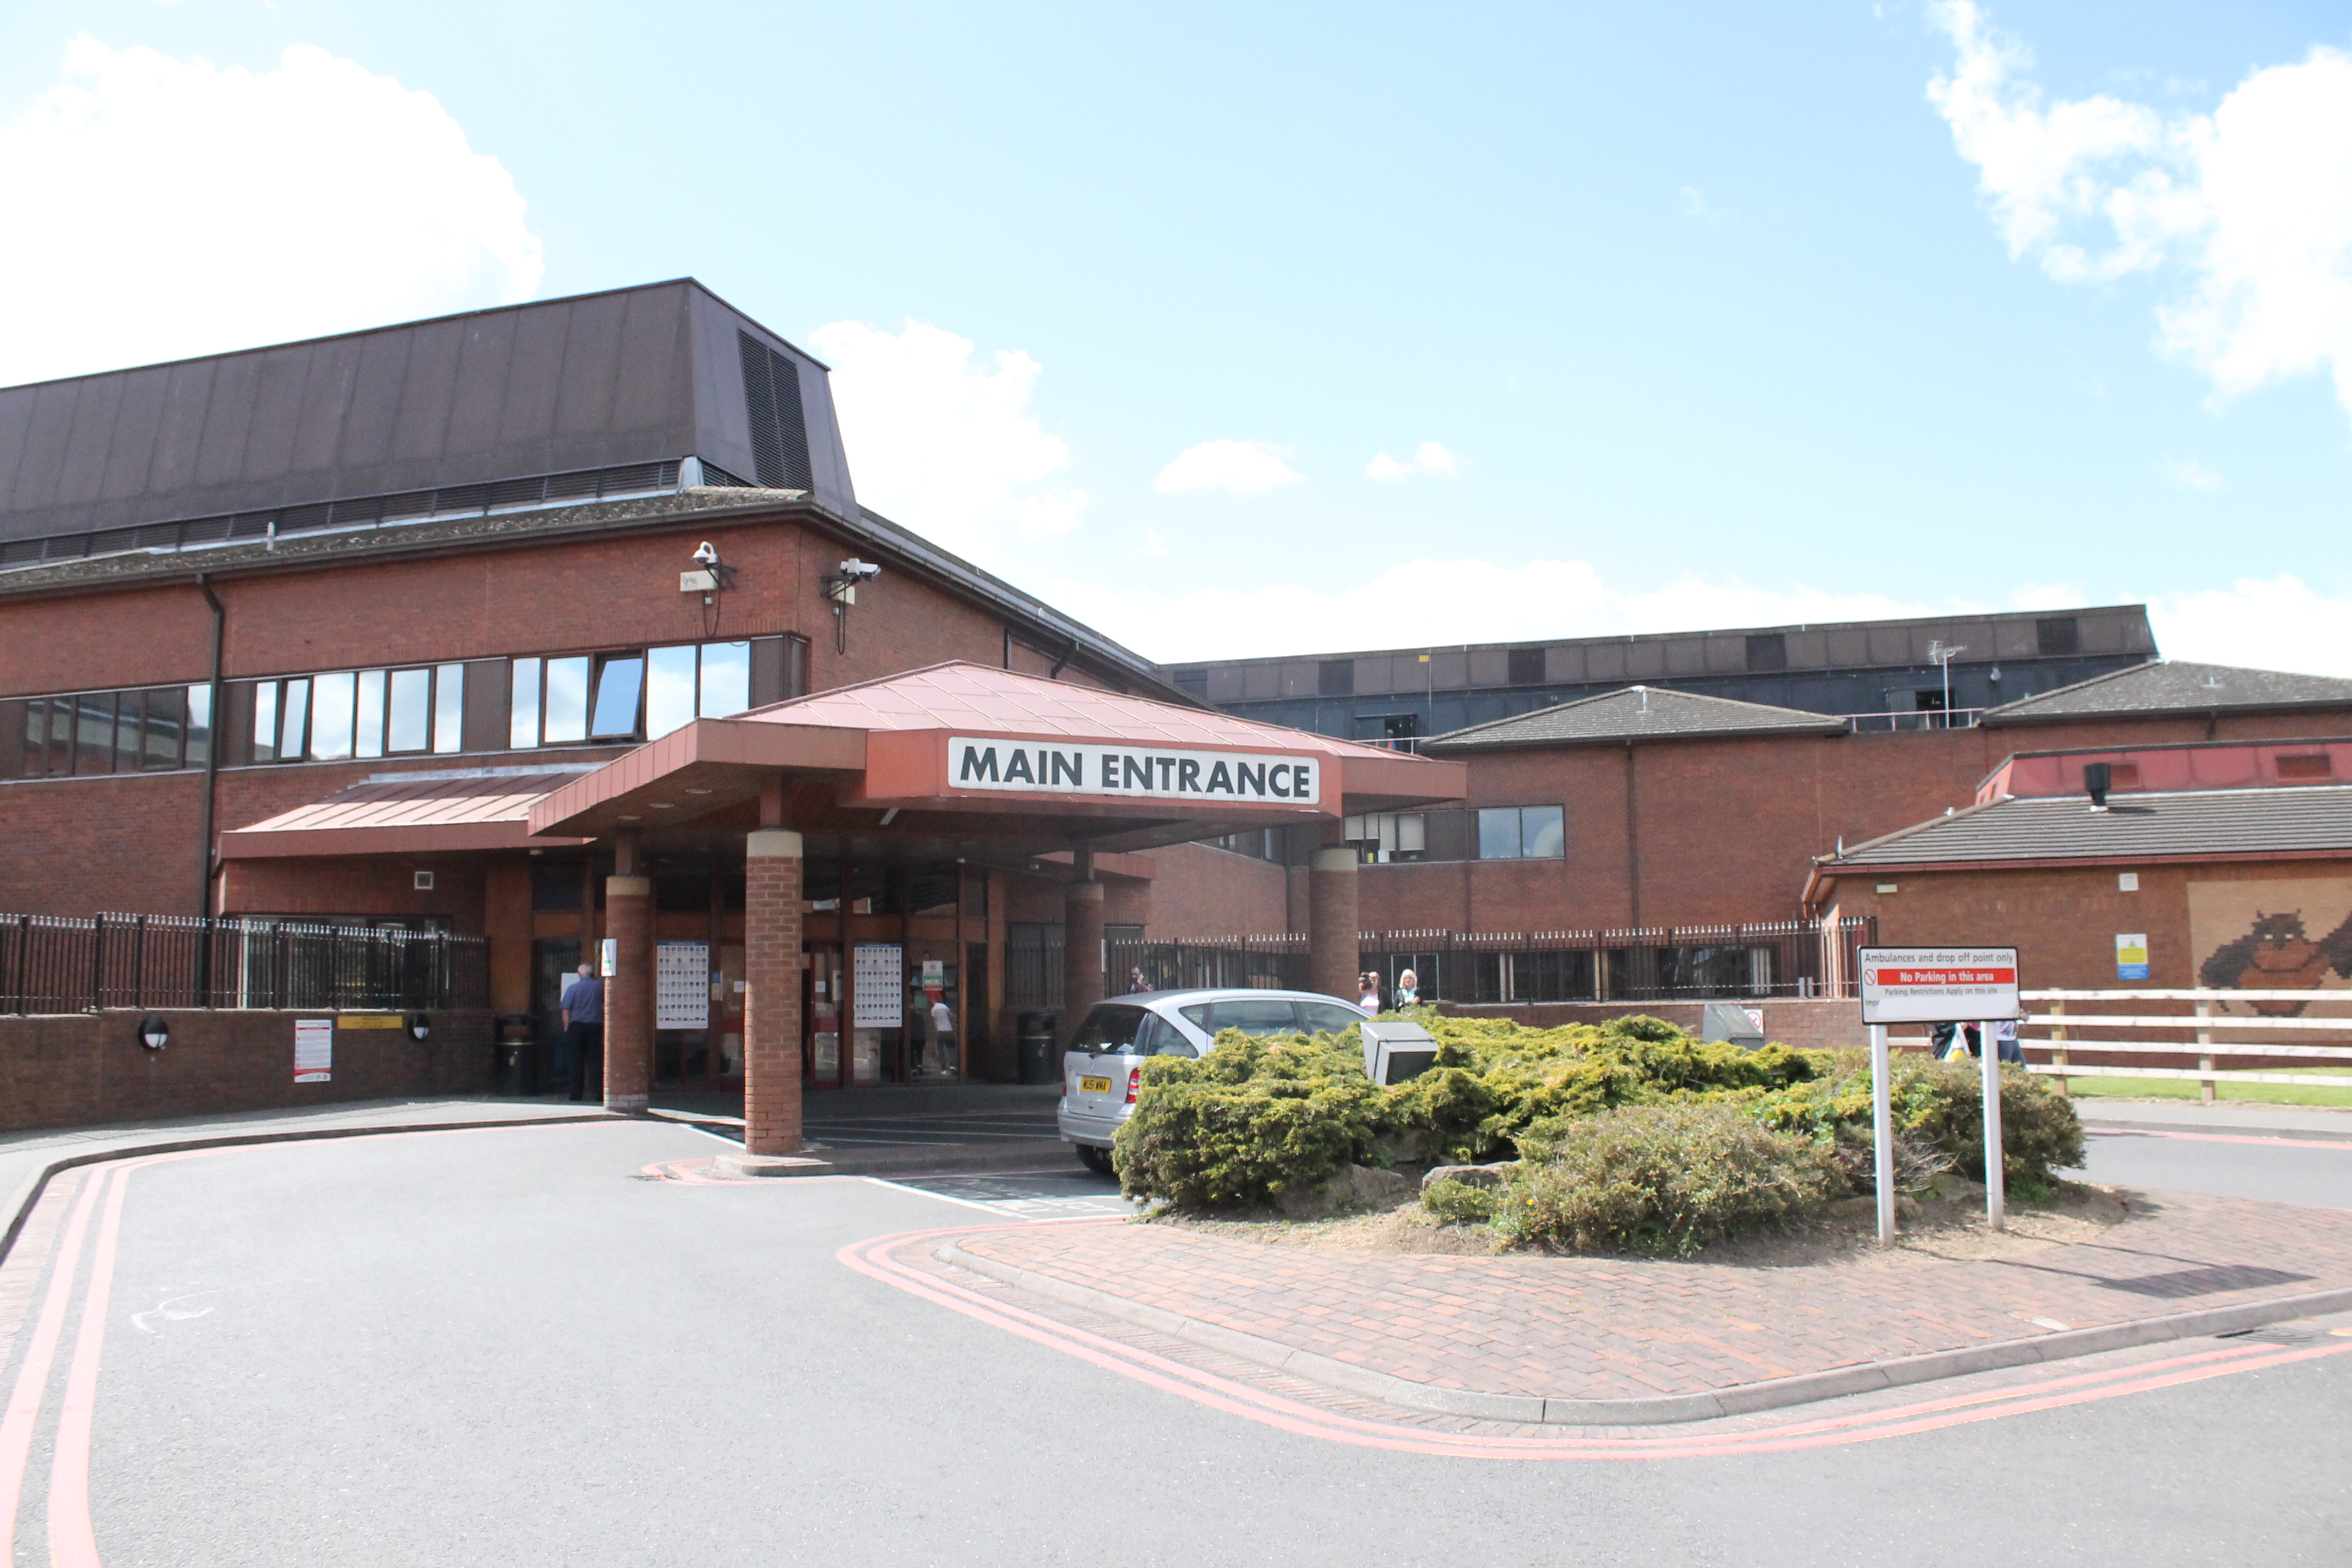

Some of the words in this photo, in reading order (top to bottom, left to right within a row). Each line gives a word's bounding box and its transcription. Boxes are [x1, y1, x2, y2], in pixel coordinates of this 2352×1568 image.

[960, 745, 1082, 786] MAIN
[1101, 754, 1310, 798] ENTRANCE
[1865, 953, 1915, 962] Ambulances
[1919, 953, 1934, 962] and
[1936, 953, 1955, 964] drop
[1959, 953, 1970, 962] off
[1973, 953, 1994, 964] point
[1997, 952, 2013, 964] only
[1901, 972, 1913, 982] No
[1915, 972, 1947, 984] Parking
[1949, 972, 1957, 982] in
[1958, 972, 1974, 982] this
[1976, 973, 1994, 981] area
[1885, 988, 1908, 997] Parking
[1947, 987, 1963, 996] Apply
